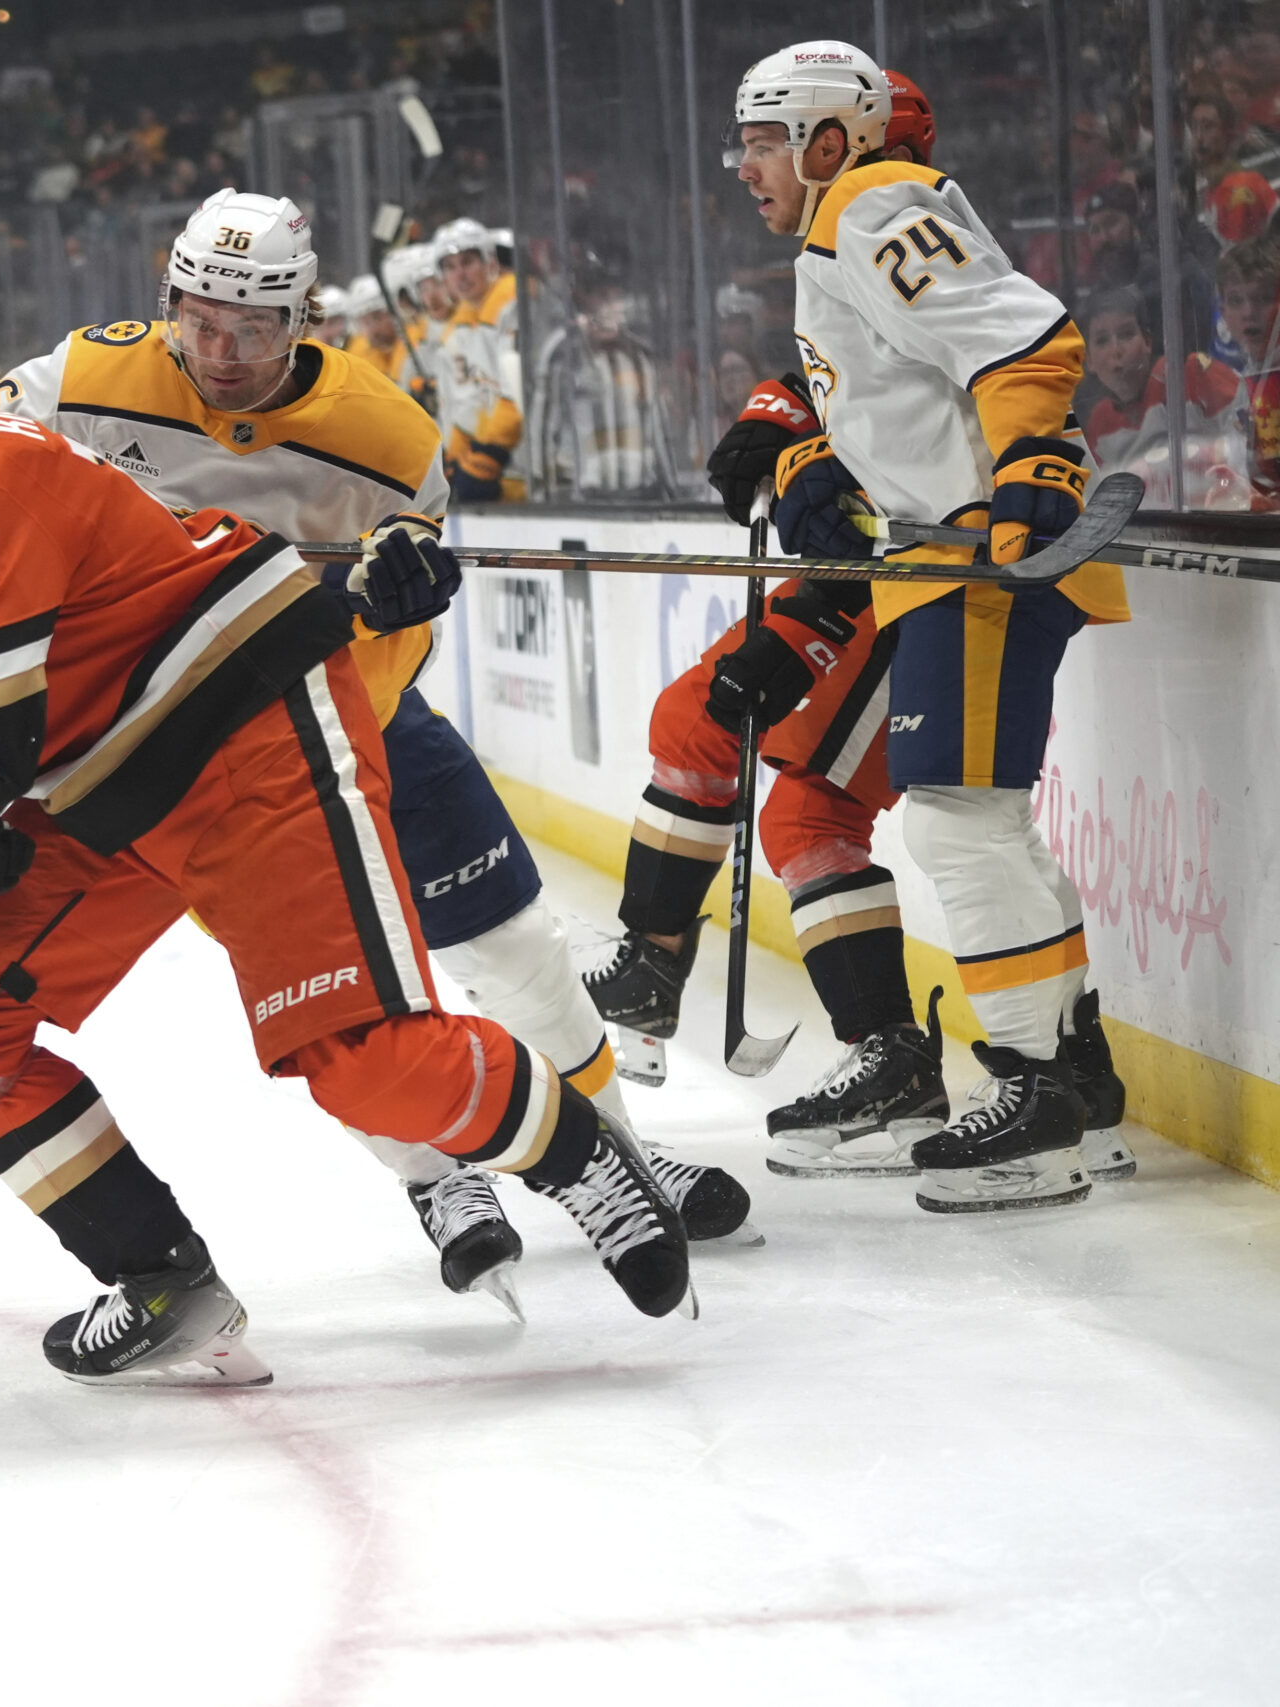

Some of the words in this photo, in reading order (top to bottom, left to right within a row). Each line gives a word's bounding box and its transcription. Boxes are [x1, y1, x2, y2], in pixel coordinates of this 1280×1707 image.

[213, 226, 254, 252] 36
[202, 263, 254, 281] CCM
[873, 214, 971, 307] 24
[104, 451, 160, 477] REGIONS
[998, 532, 1026, 551] CCM
[1142, 547, 1241, 578] CCM
[818, 616, 844, 636] GAUTHIER
[720, 675, 744, 693] CCM
[420, 836, 510, 899] CCM
[730, 819, 748, 929] CCM
[255, 965, 360, 1025] BAUER
[110, 1338, 152, 1368] BAUER
